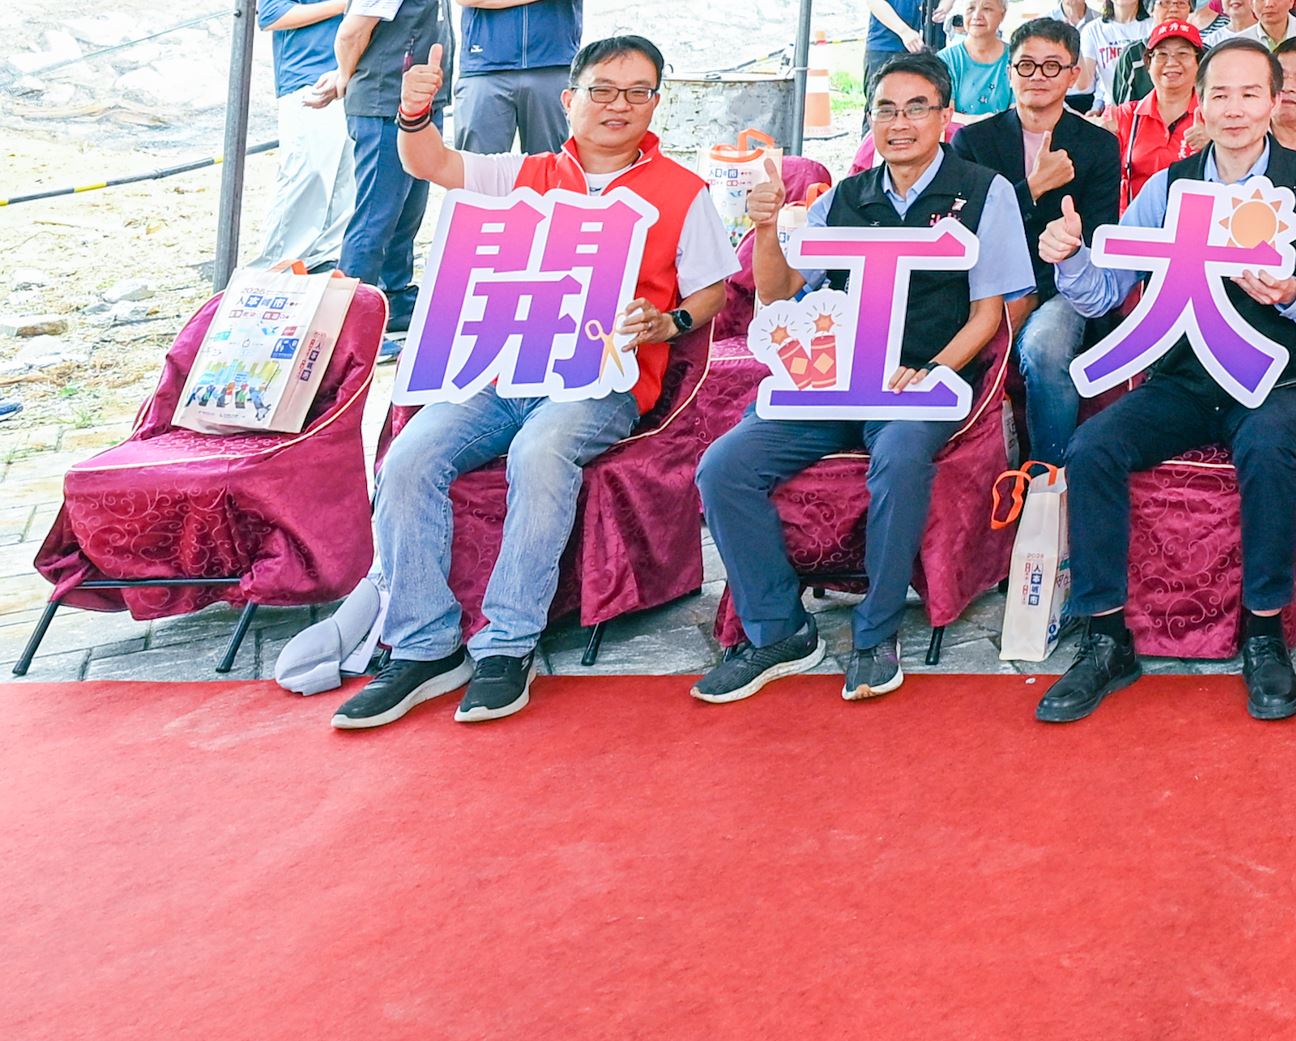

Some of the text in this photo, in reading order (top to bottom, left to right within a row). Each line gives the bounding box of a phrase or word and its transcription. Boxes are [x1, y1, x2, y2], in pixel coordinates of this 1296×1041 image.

[407, 199, 643, 392] 開
[769, 231, 967, 407] 工
[1083, 192, 1283, 394] 大
